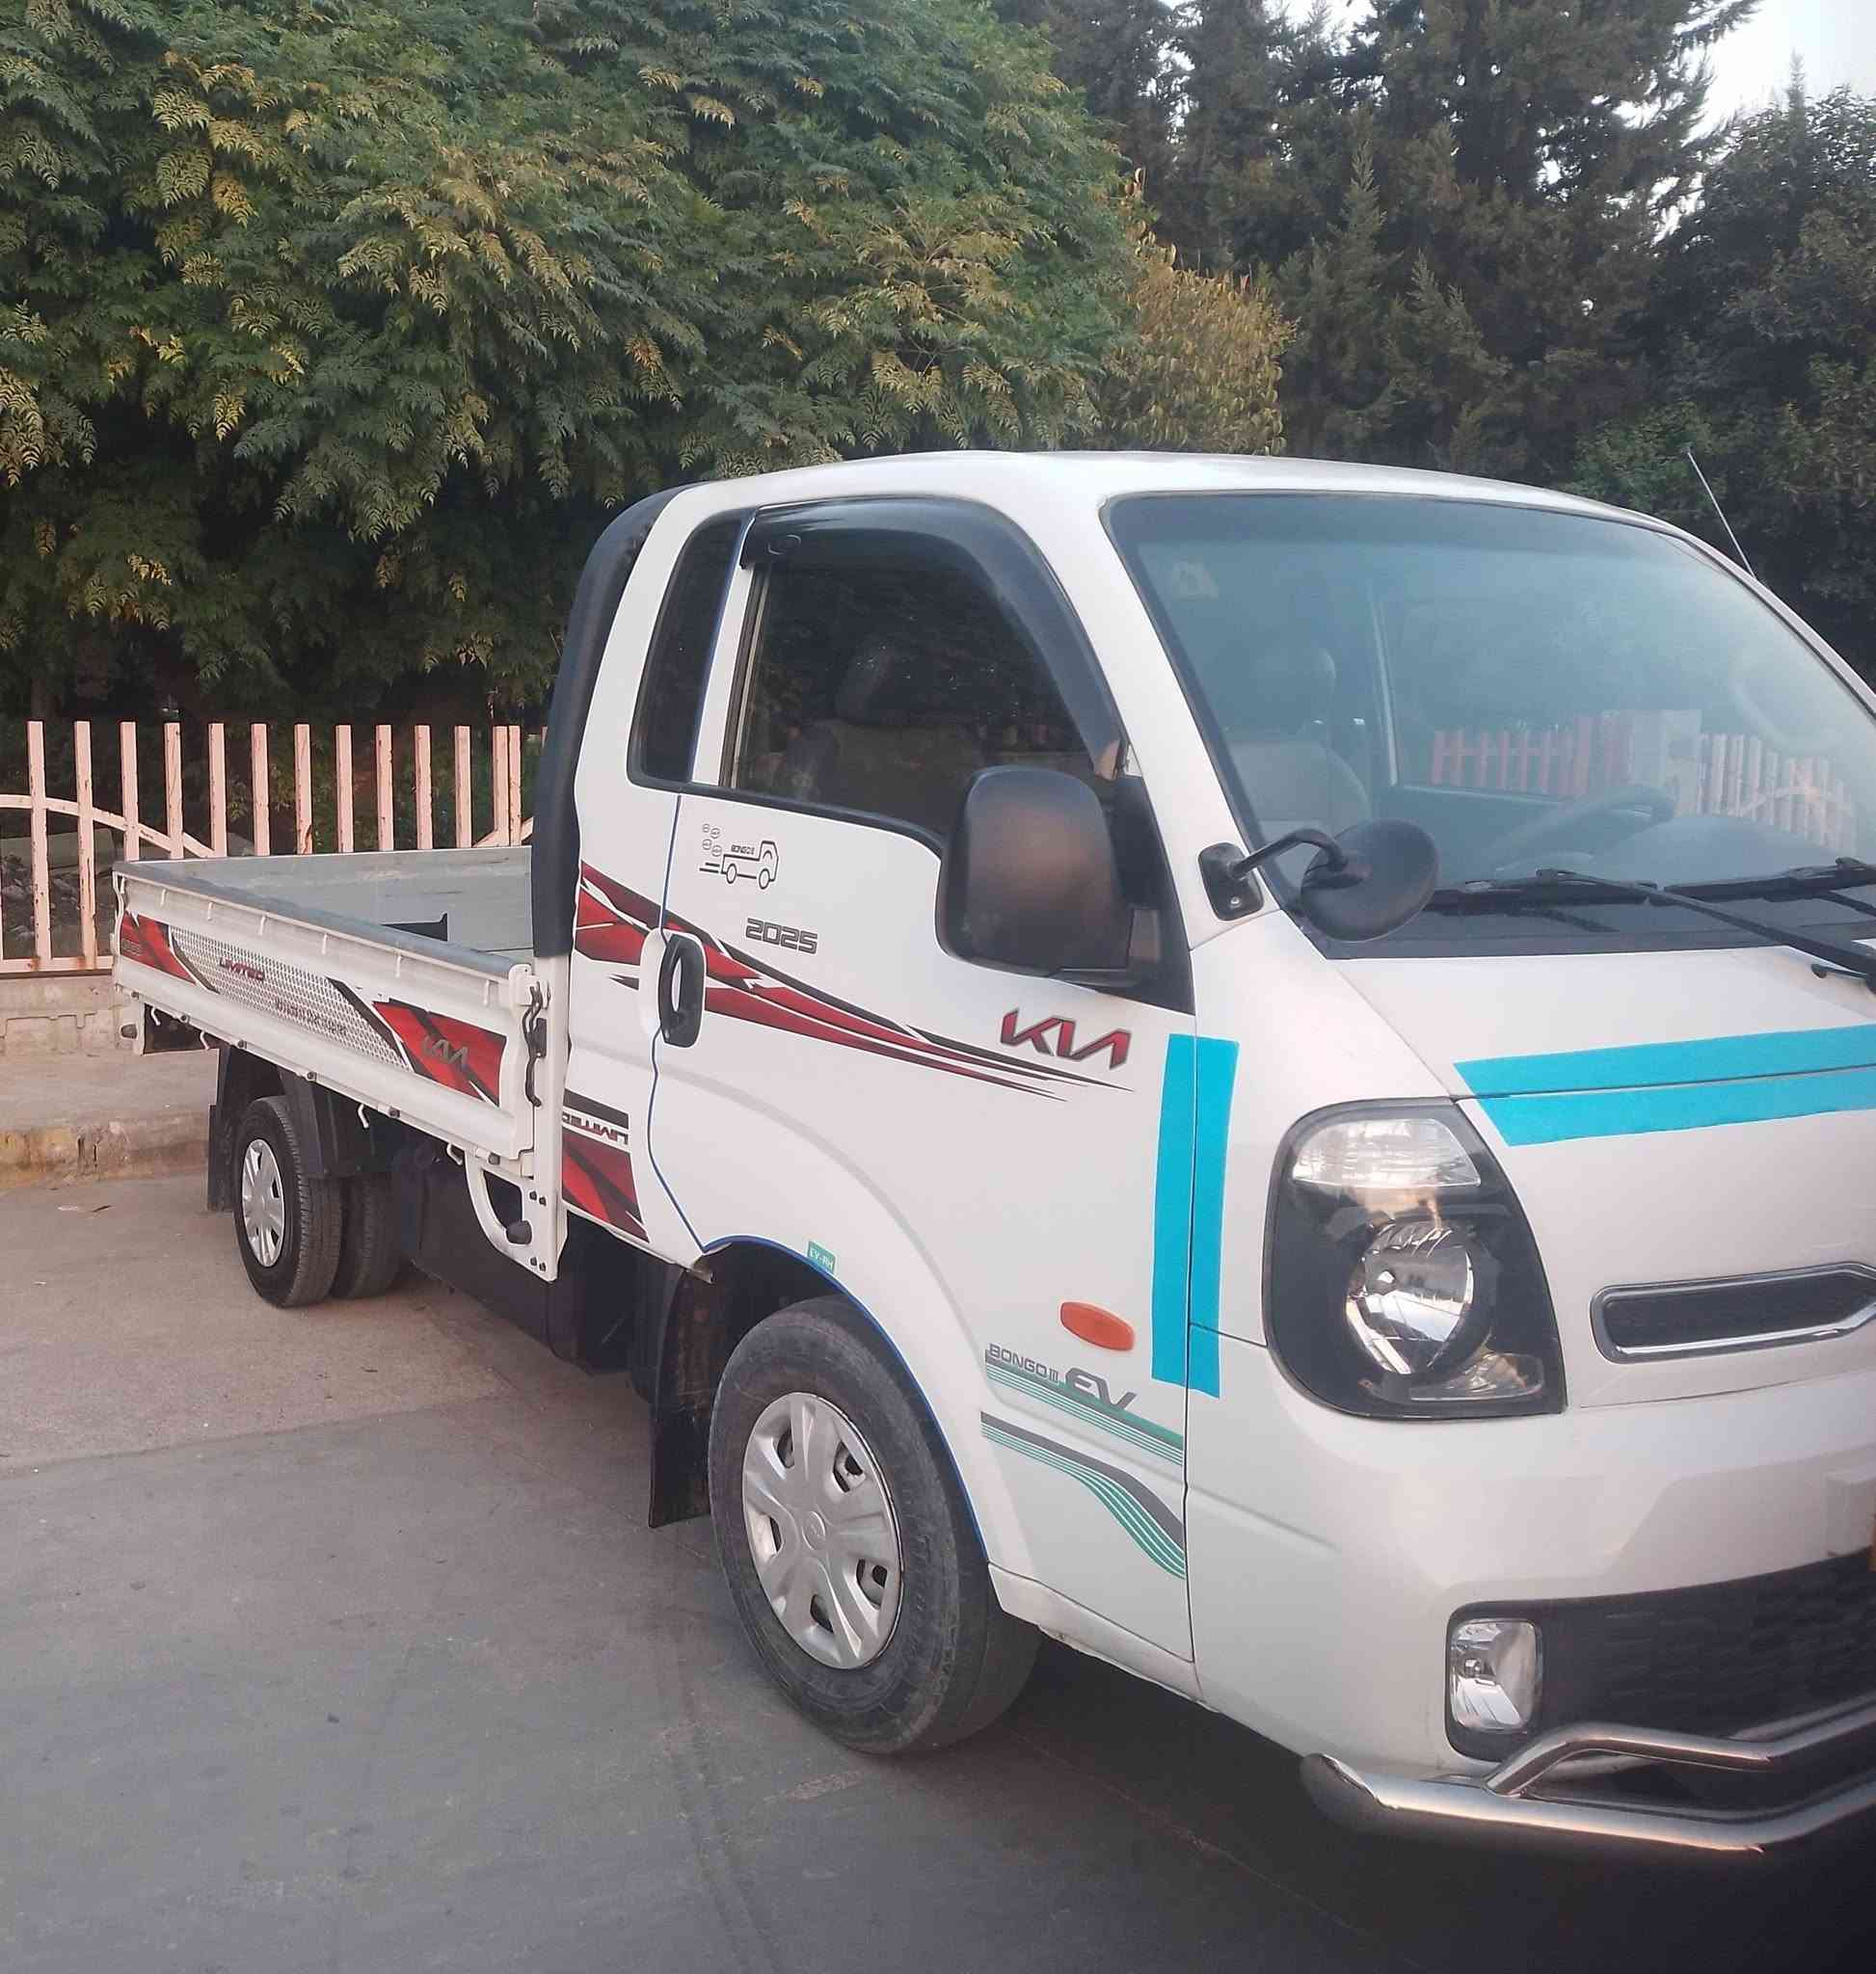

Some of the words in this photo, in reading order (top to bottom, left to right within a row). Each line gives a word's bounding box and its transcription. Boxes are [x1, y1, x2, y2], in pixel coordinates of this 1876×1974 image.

[745, 918, 817, 954] 2025
[1001, 1009, 1132, 1070] KIA
[989, 1344, 1047, 1378] BONGO
[1065, 1367, 1137, 1410] EV
